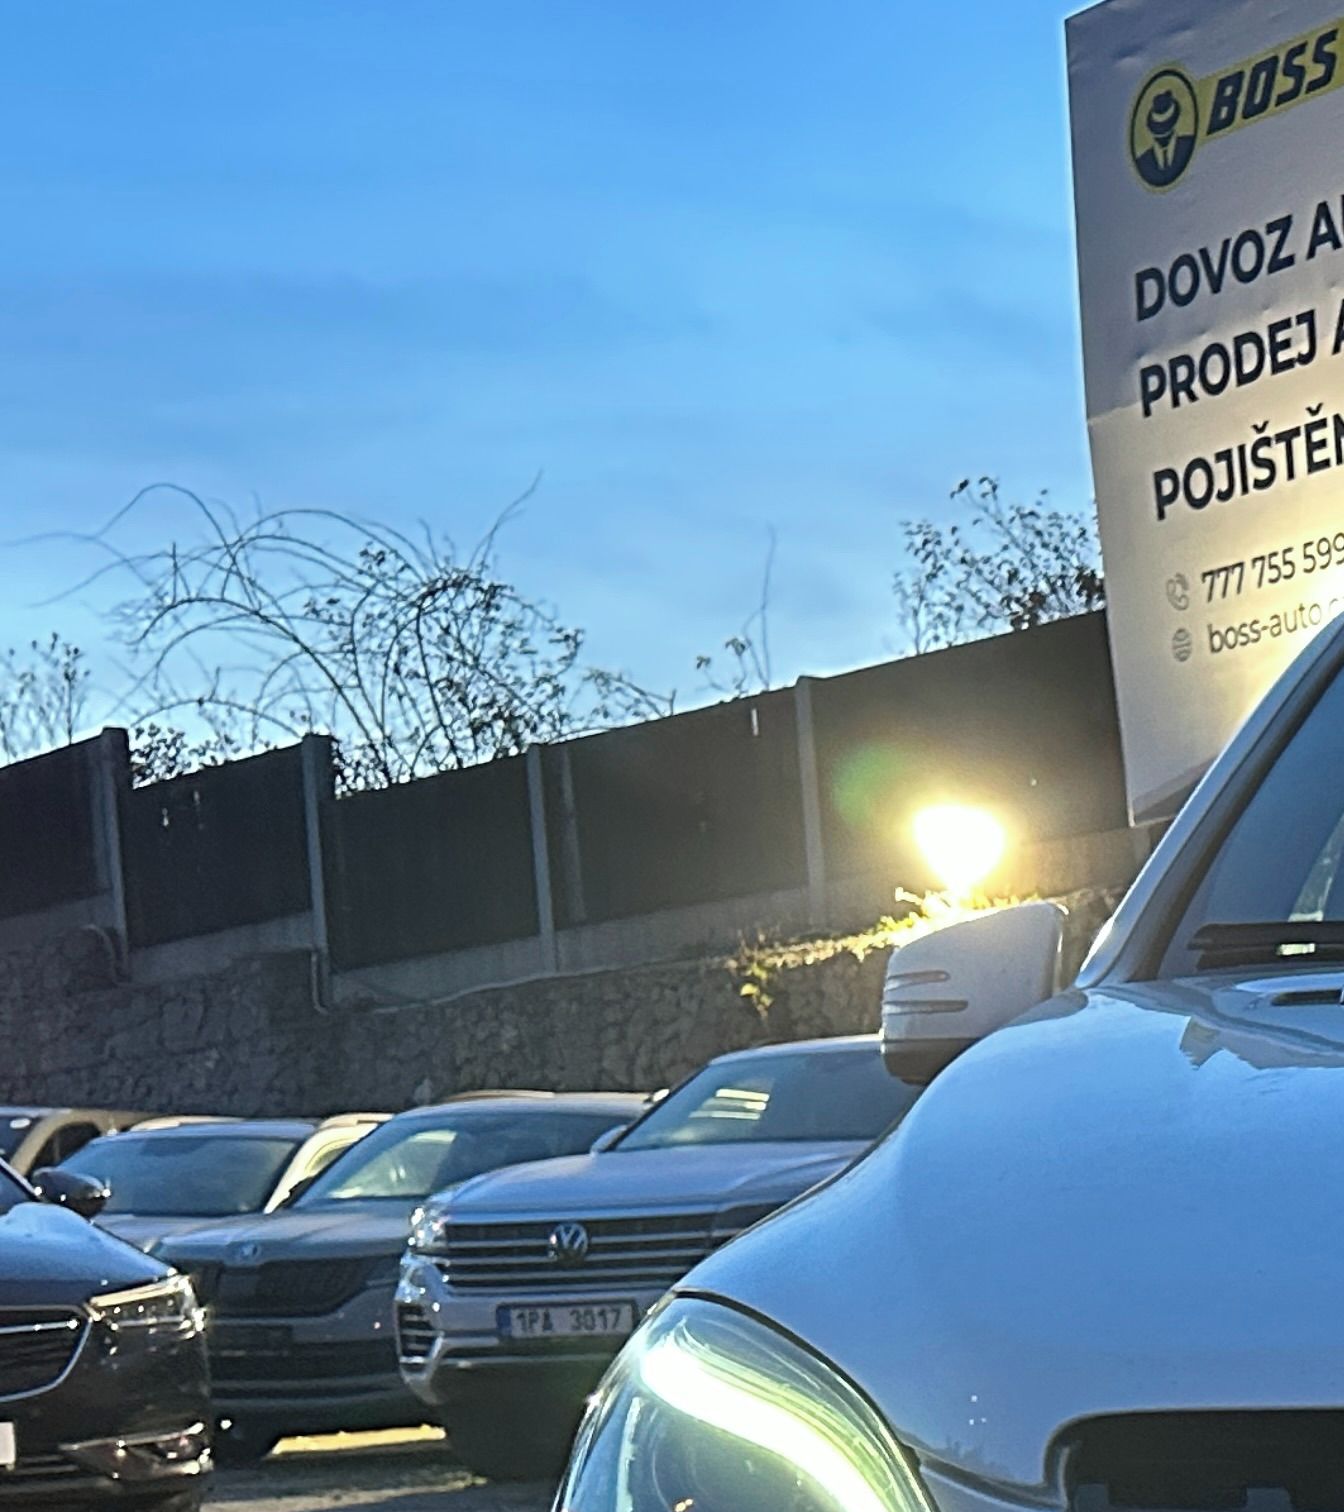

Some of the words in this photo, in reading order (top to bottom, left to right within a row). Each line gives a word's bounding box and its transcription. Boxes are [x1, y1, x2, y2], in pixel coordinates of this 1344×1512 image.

[1205, 30, 1338, 137] BOSS
[1135, 214, 1294, 322] DOVOZ
[1140, 313, 1317, 417] PRODEJ
[1201, 562, 1245, 603] 777
[1252, 547, 1296, 588] 755
